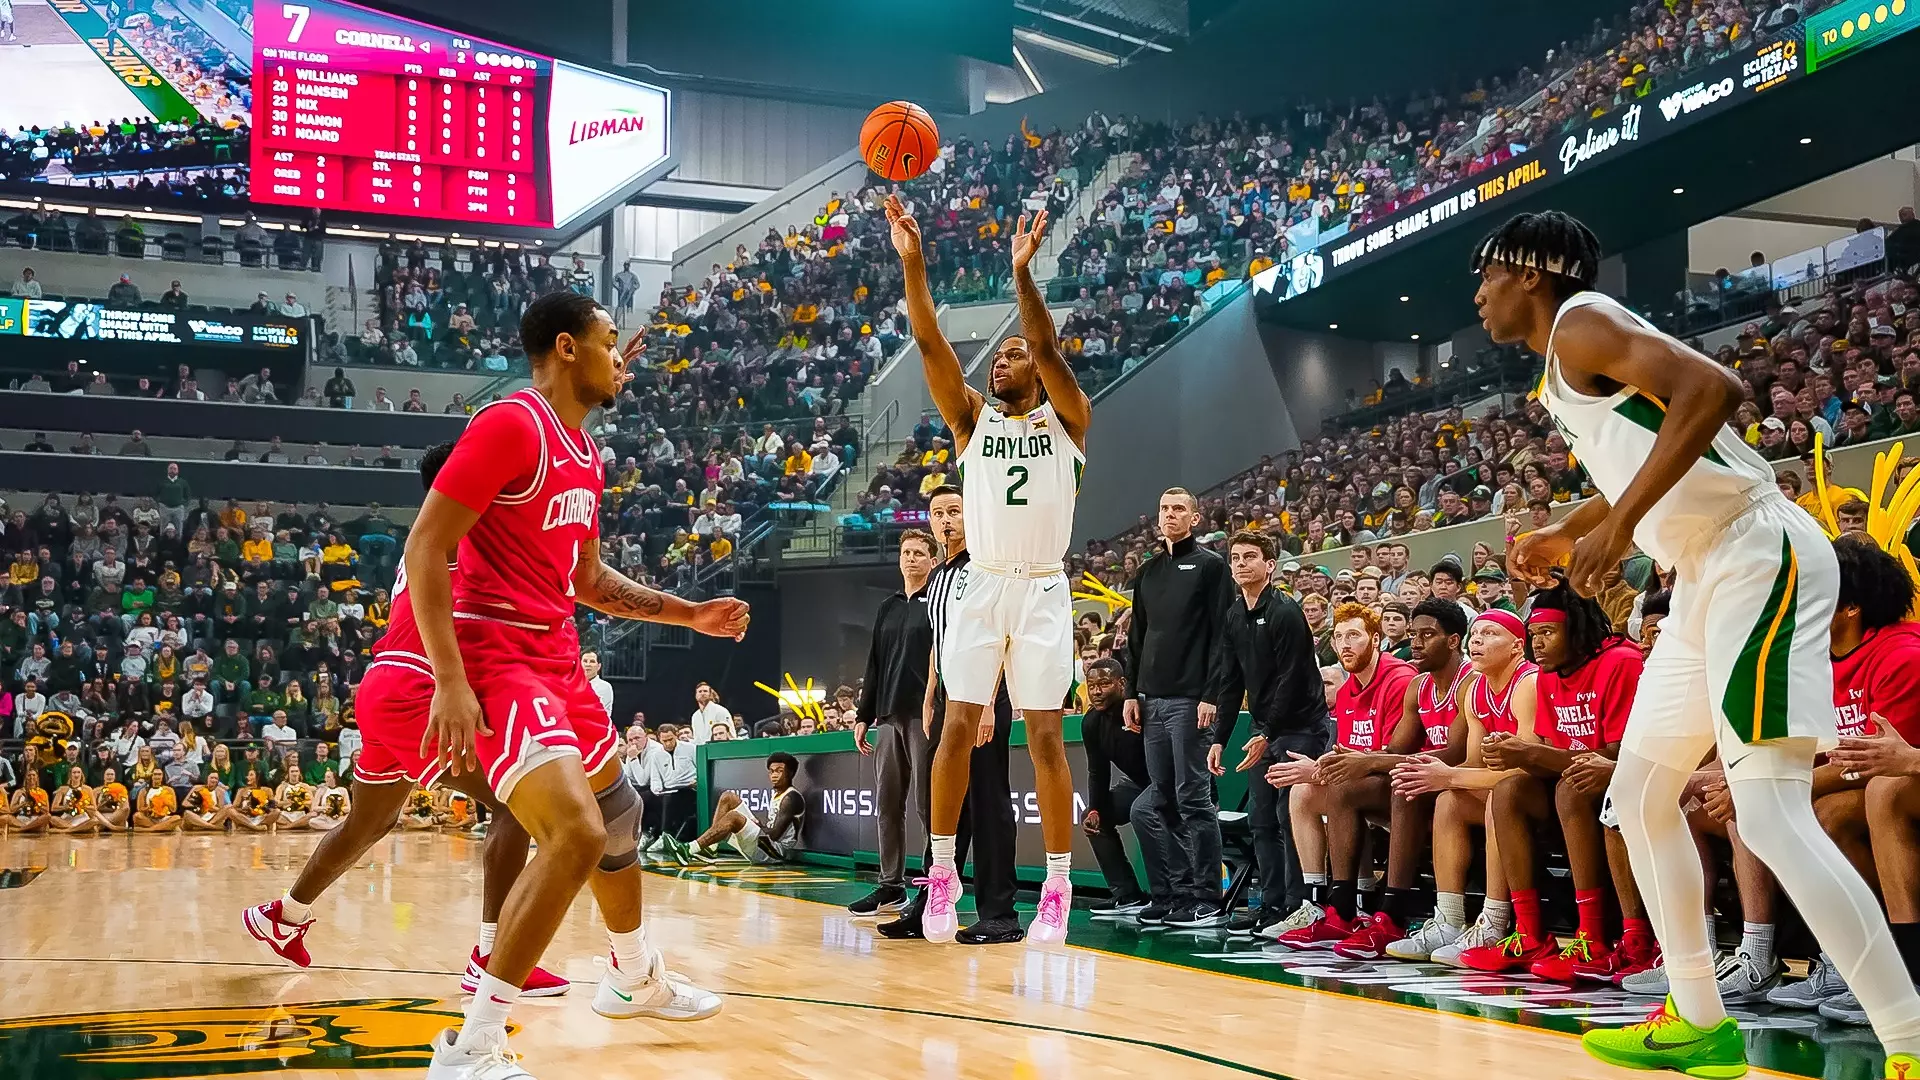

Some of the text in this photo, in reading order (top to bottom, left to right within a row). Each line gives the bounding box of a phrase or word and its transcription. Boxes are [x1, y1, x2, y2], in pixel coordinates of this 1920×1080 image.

[284, 5, 309, 42] 7
[336, 30, 415, 52] CORNELL
[263, 48, 328, 63] ON THE FLOOR
[458, 52, 465, 63] 2
[1743, 48, 1782, 77] ECLIPSE
[278, 66, 358, 86] 1 WILLIAMS
[405, 64, 422, 73] PTS
[474, 72, 490, 81] AST
[1760, 55, 1798, 82] TEXAS
[273, 80, 349, 100] 20 HANSEN
[273, 95, 318, 110] 23 NIX
[273, 110, 342, 129] 30 MANON
[272, 125, 341, 142] 31 NOARD
[409, 125, 416, 135] 2
[568, 116, 644, 146] LIBMAN
[1559, 103, 1642, 175] Believe it!
[274, 152, 325, 167] AST 2
[373, 162, 390, 171] STL
[373, 178, 392, 187] BLK
[372, 194, 419, 207] TO 1
[508, 206, 514, 215] 1
[1332, 159, 1547, 268] THROW SOME SHADE WITH US THIS APRIL.
[99, 310, 175, 325] THROW SOME
[99, 318, 170, 334] SHADE WITH
[99, 328, 116, 338] US
[115, 328, 145, 340] THIS
[981, 433, 1053, 459] BAYLOR
[1006, 465, 1029, 506] 2
[532, 696, 557, 727] C
